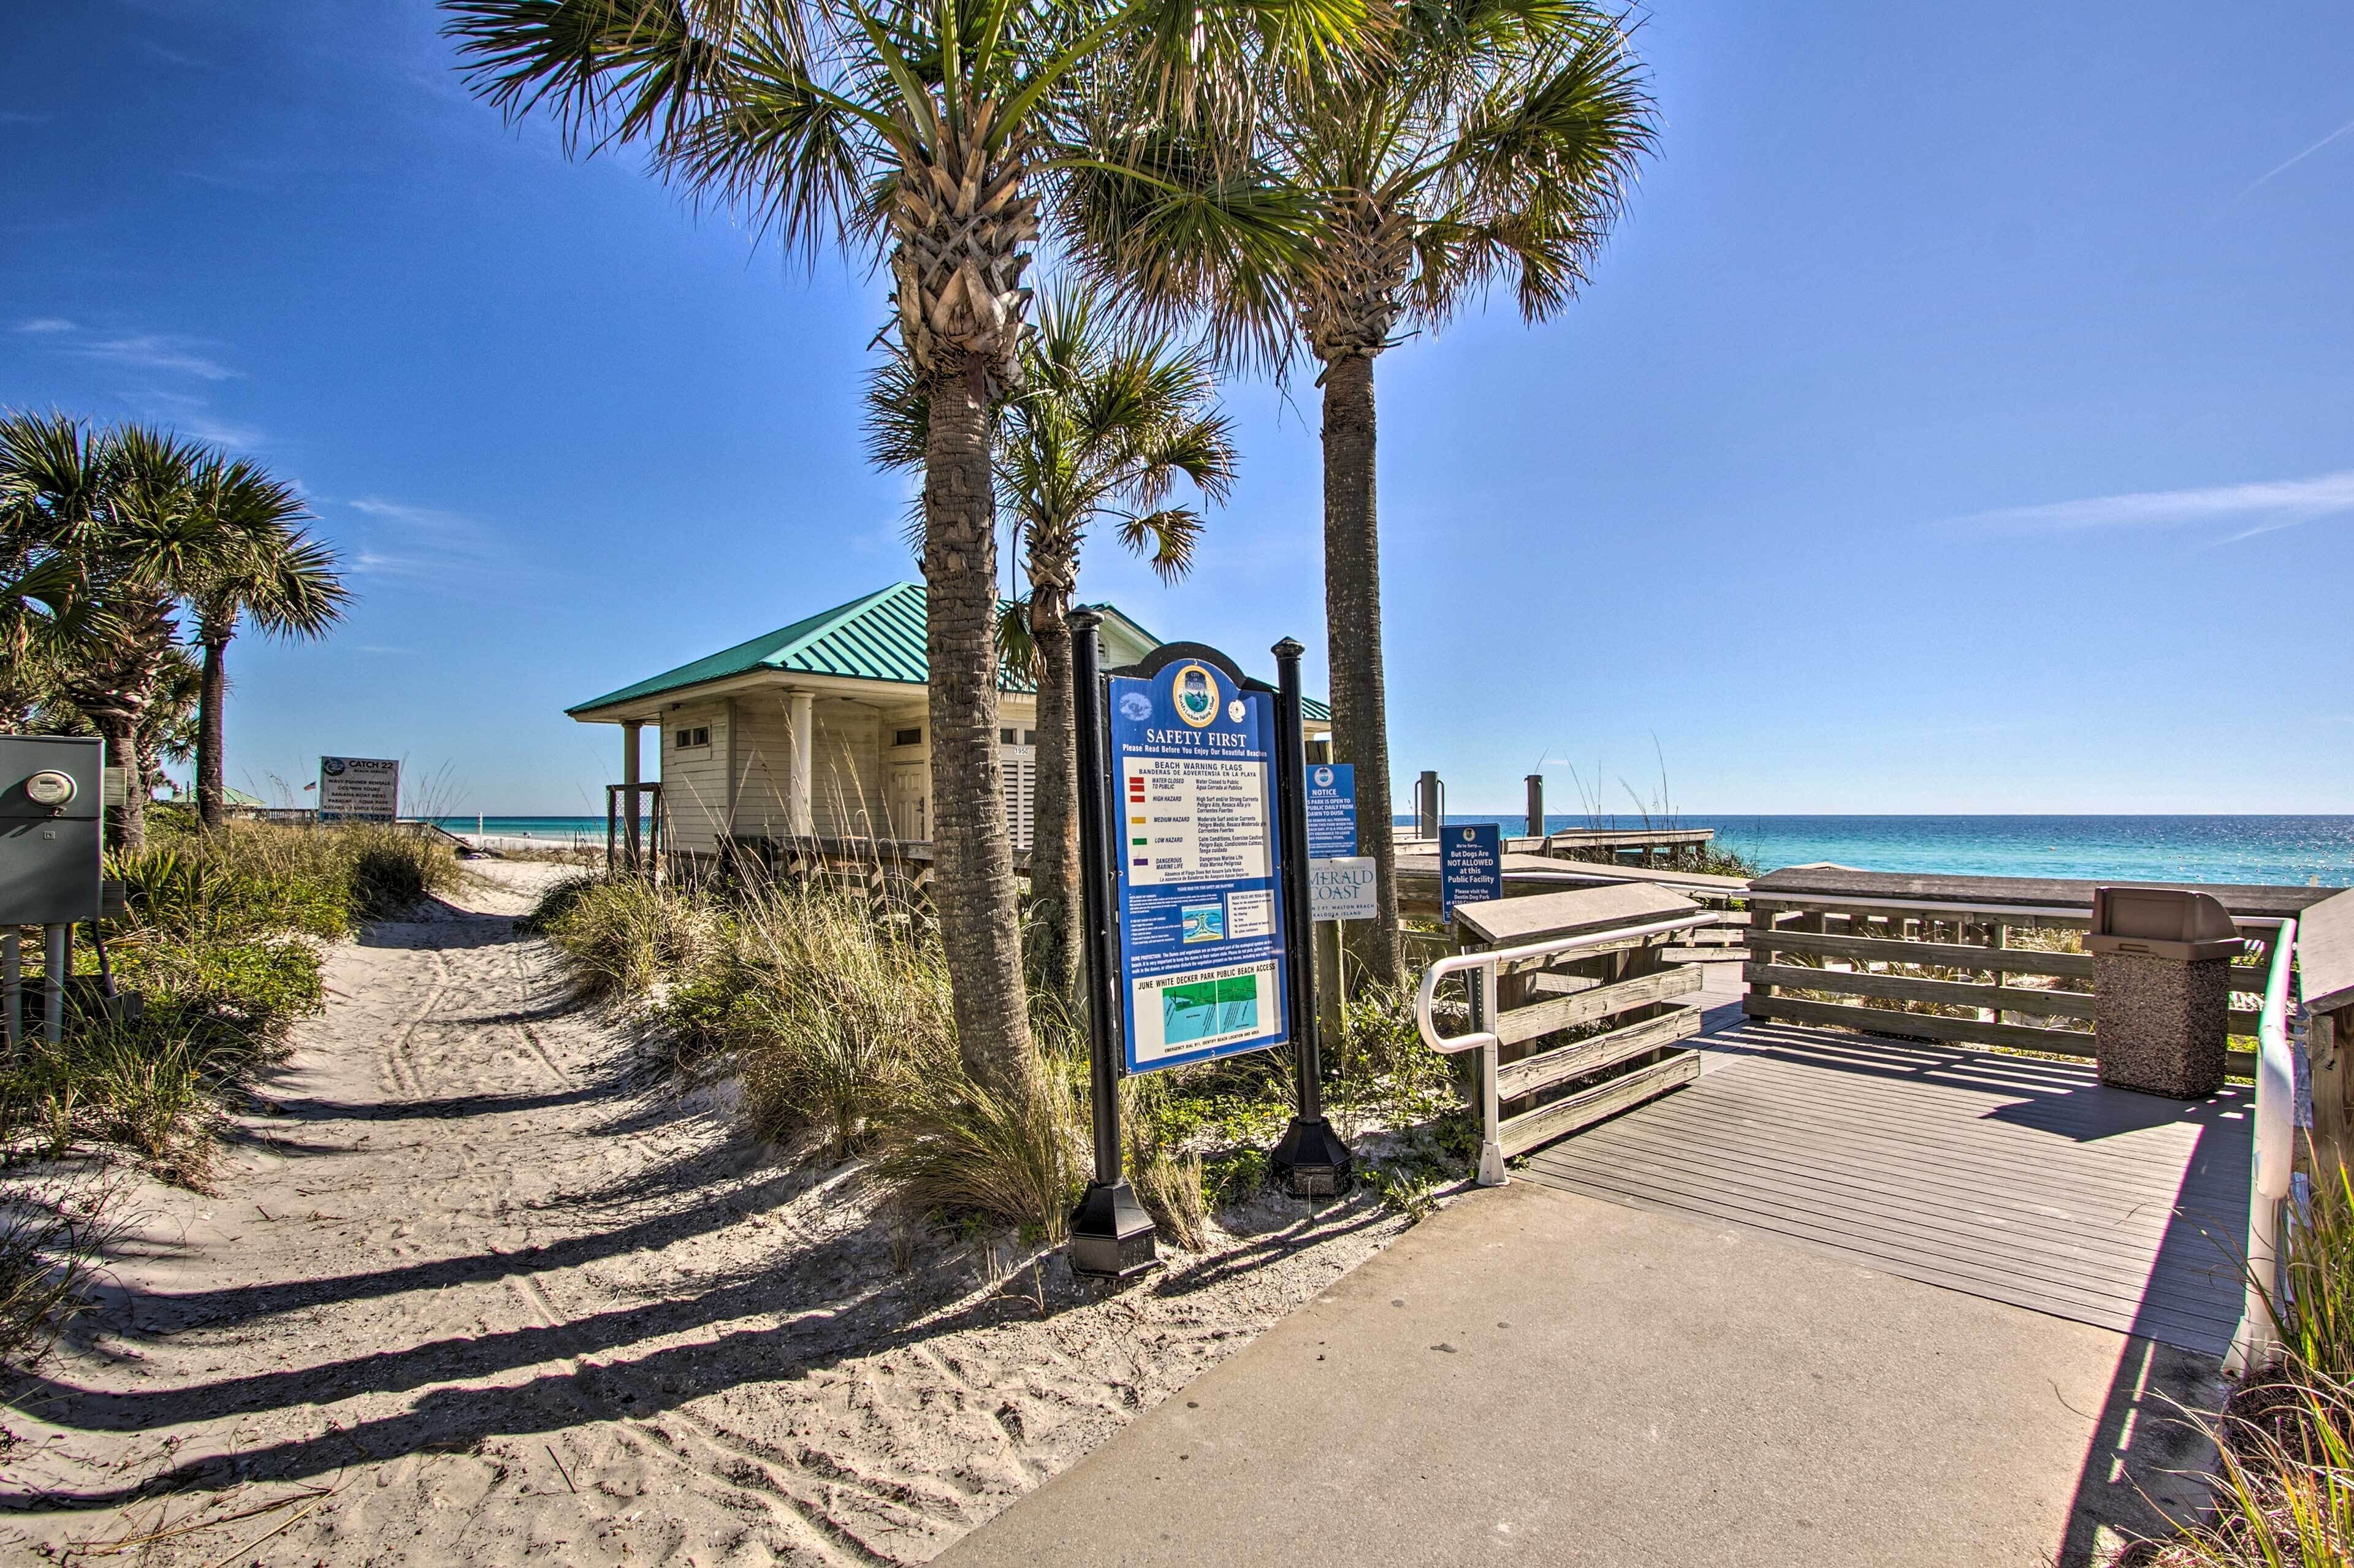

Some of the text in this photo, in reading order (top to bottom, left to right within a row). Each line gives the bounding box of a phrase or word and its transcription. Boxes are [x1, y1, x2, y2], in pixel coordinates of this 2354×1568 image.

[1146, 728, 1247, 747] SAFETY FIRST
[1162, 745, 1180, 754] Before
[1194, 747, 1209, 756] Enjoy
[1310, 870, 1373, 885] MERALD
[1470, 875, 1495, 884] Facility
[1138, 963, 1275, 989] JUNE WHITE DECKER PARK PUBLIC BEACH ACCESS
